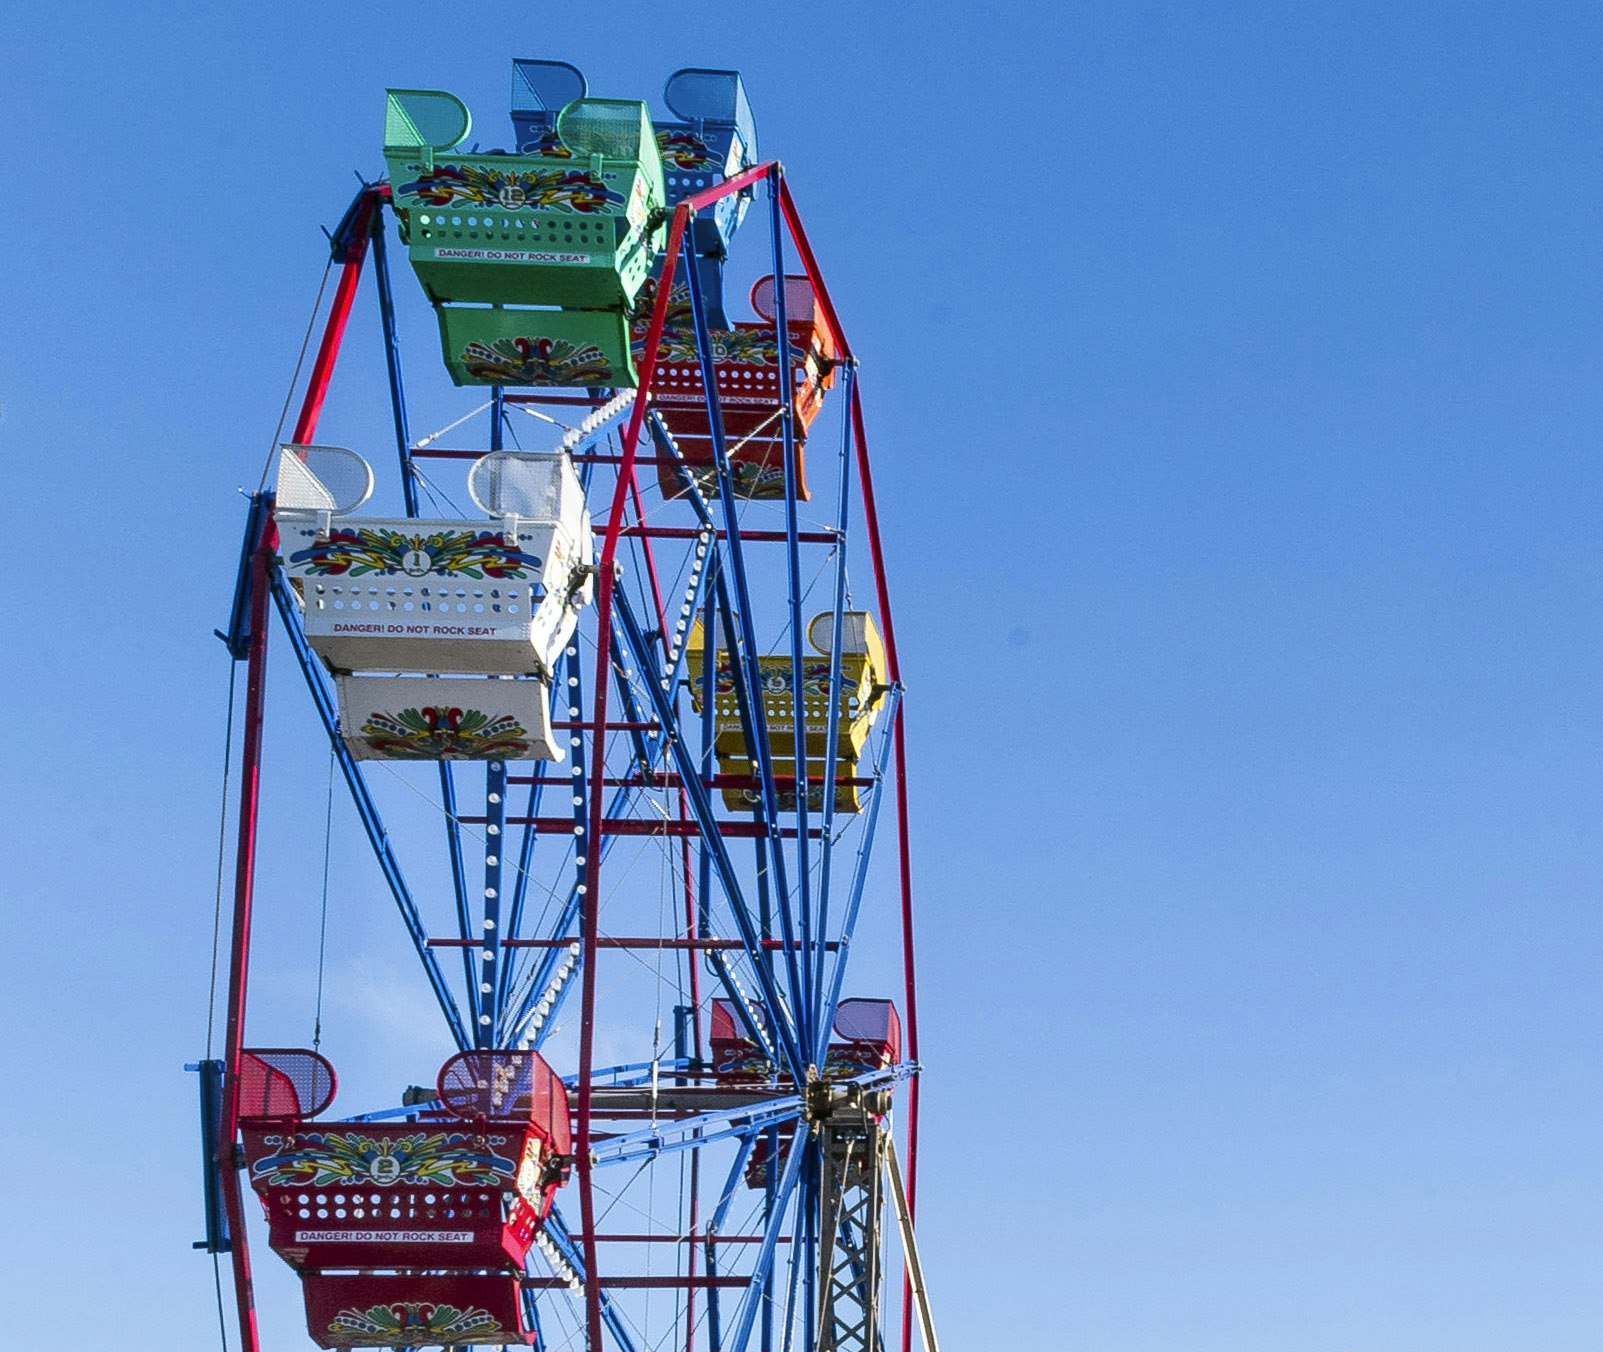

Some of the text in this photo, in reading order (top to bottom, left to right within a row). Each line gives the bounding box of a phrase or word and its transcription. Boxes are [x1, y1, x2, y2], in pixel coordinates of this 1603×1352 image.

[503, 188, 523, 201] 12
[438, 249, 587, 263] DANGER! DO NOT ROCK SEAT
[412, 552, 421, 567] 1
[333, 623, 497, 636] DANGER! DO NOT ROCK SEAT
[378, 1158, 393, 1174] 2
[300, 1231, 469, 1242] DANGER! DO NOT ROCK SEAT
